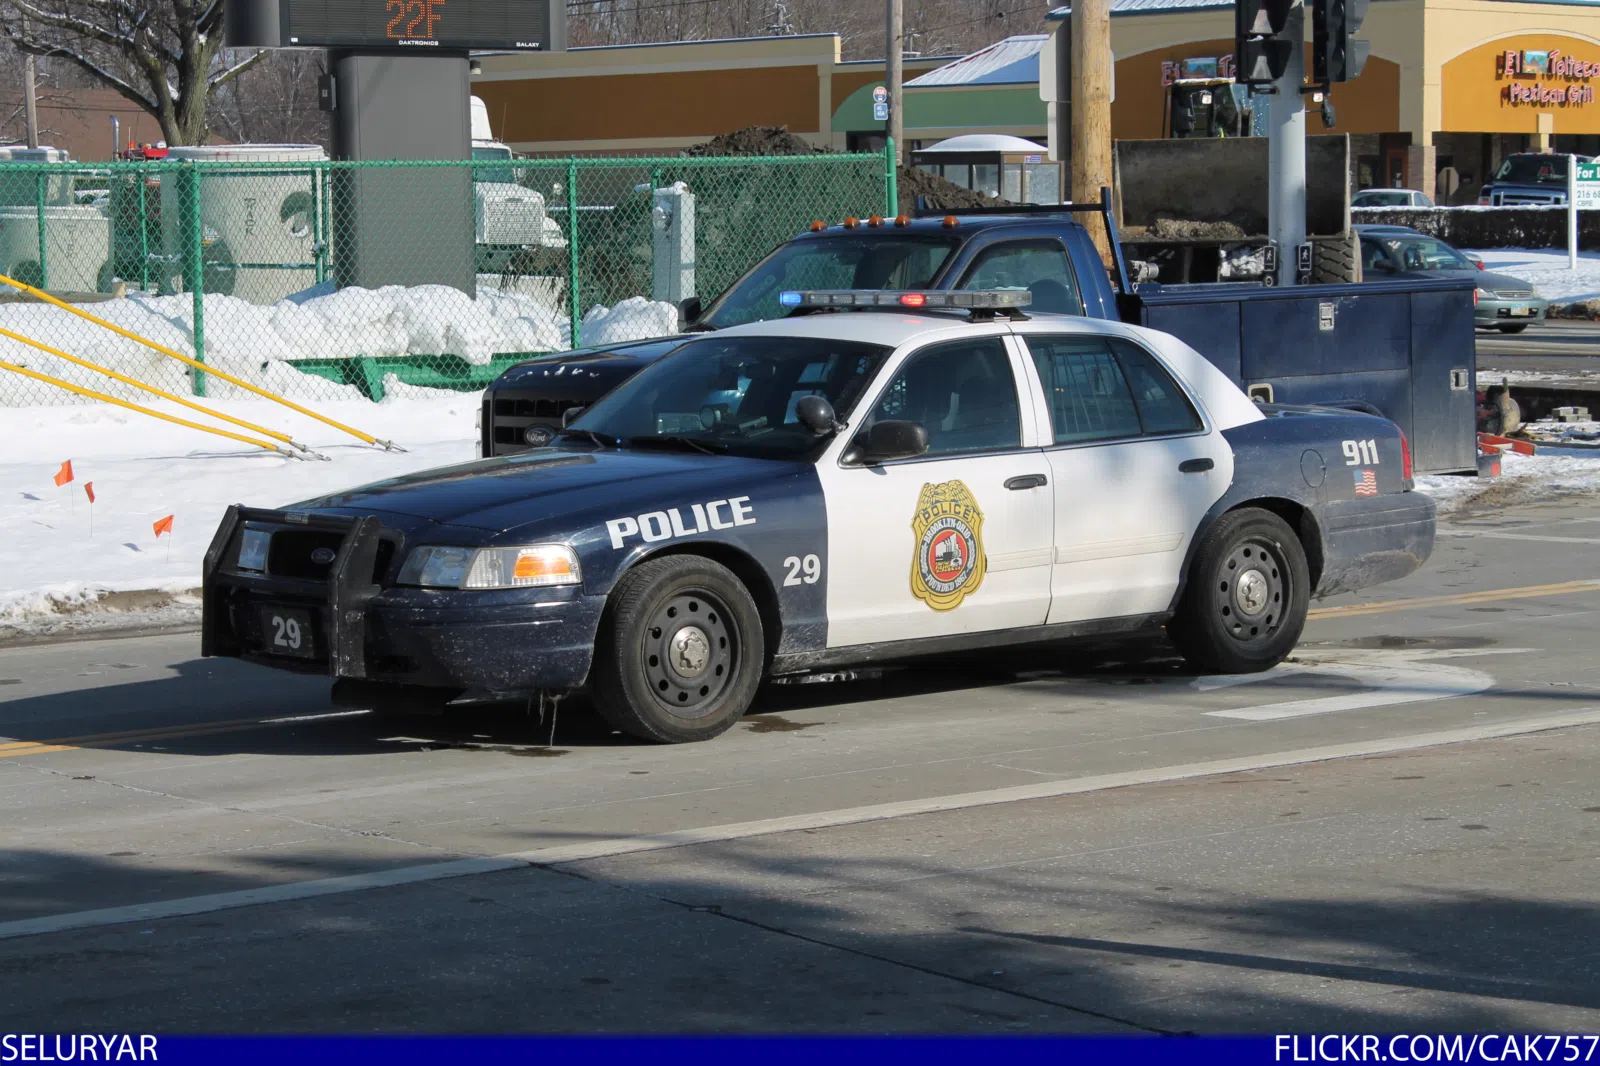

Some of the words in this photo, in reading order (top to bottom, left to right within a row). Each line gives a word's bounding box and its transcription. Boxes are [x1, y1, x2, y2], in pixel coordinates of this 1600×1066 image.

[386, 0, 445, 38] 22F
[1504, 50, 1520, 75] El
[1549, 49, 1600, 78] Tolteca
[1510, 83, 1566, 103] Mexican
[1568, 85, 1595, 103] Grill
[1576, 166, 1594, 179] For
[1577, 190, 1591, 199] 216
[1342, 438, 1380, 466] 911
[605, 495, 756, 550] POLICE
[922, 502, 972, 523] POLICE
[783, 553, 821, 587] 29
[925, 573, 955, 593] FOUNDED
[272, 615, 301, 649] 29
